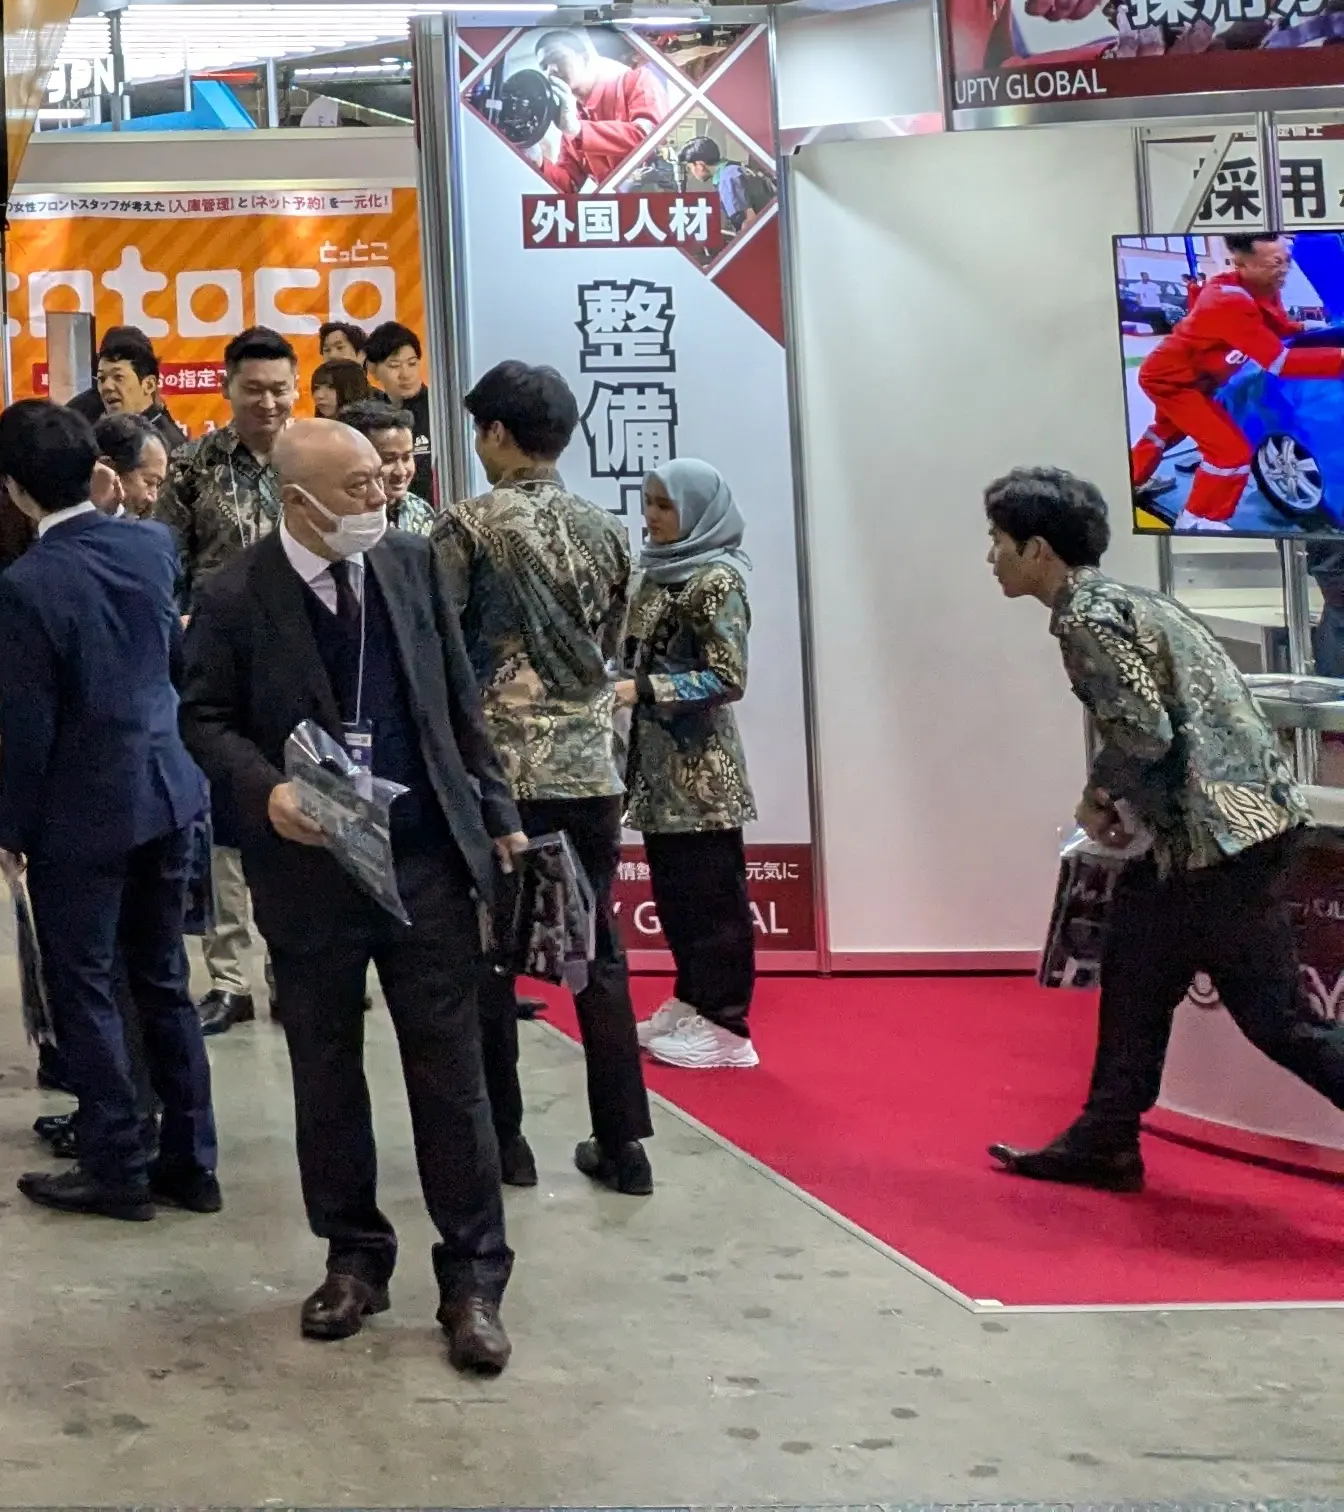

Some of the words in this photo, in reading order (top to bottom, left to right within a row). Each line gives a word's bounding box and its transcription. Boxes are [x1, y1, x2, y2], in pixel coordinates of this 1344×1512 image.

[954, 76, 1000, 104] UPTY
[1006, 67, 1108, 100] GLOBAL
[1192, 156, 1344, 221] 採用
[530, 197, 713, 243] 外国人材
[319, 239, 390, 264] とっとこ
[745, 861, 800, 881] 元気に
